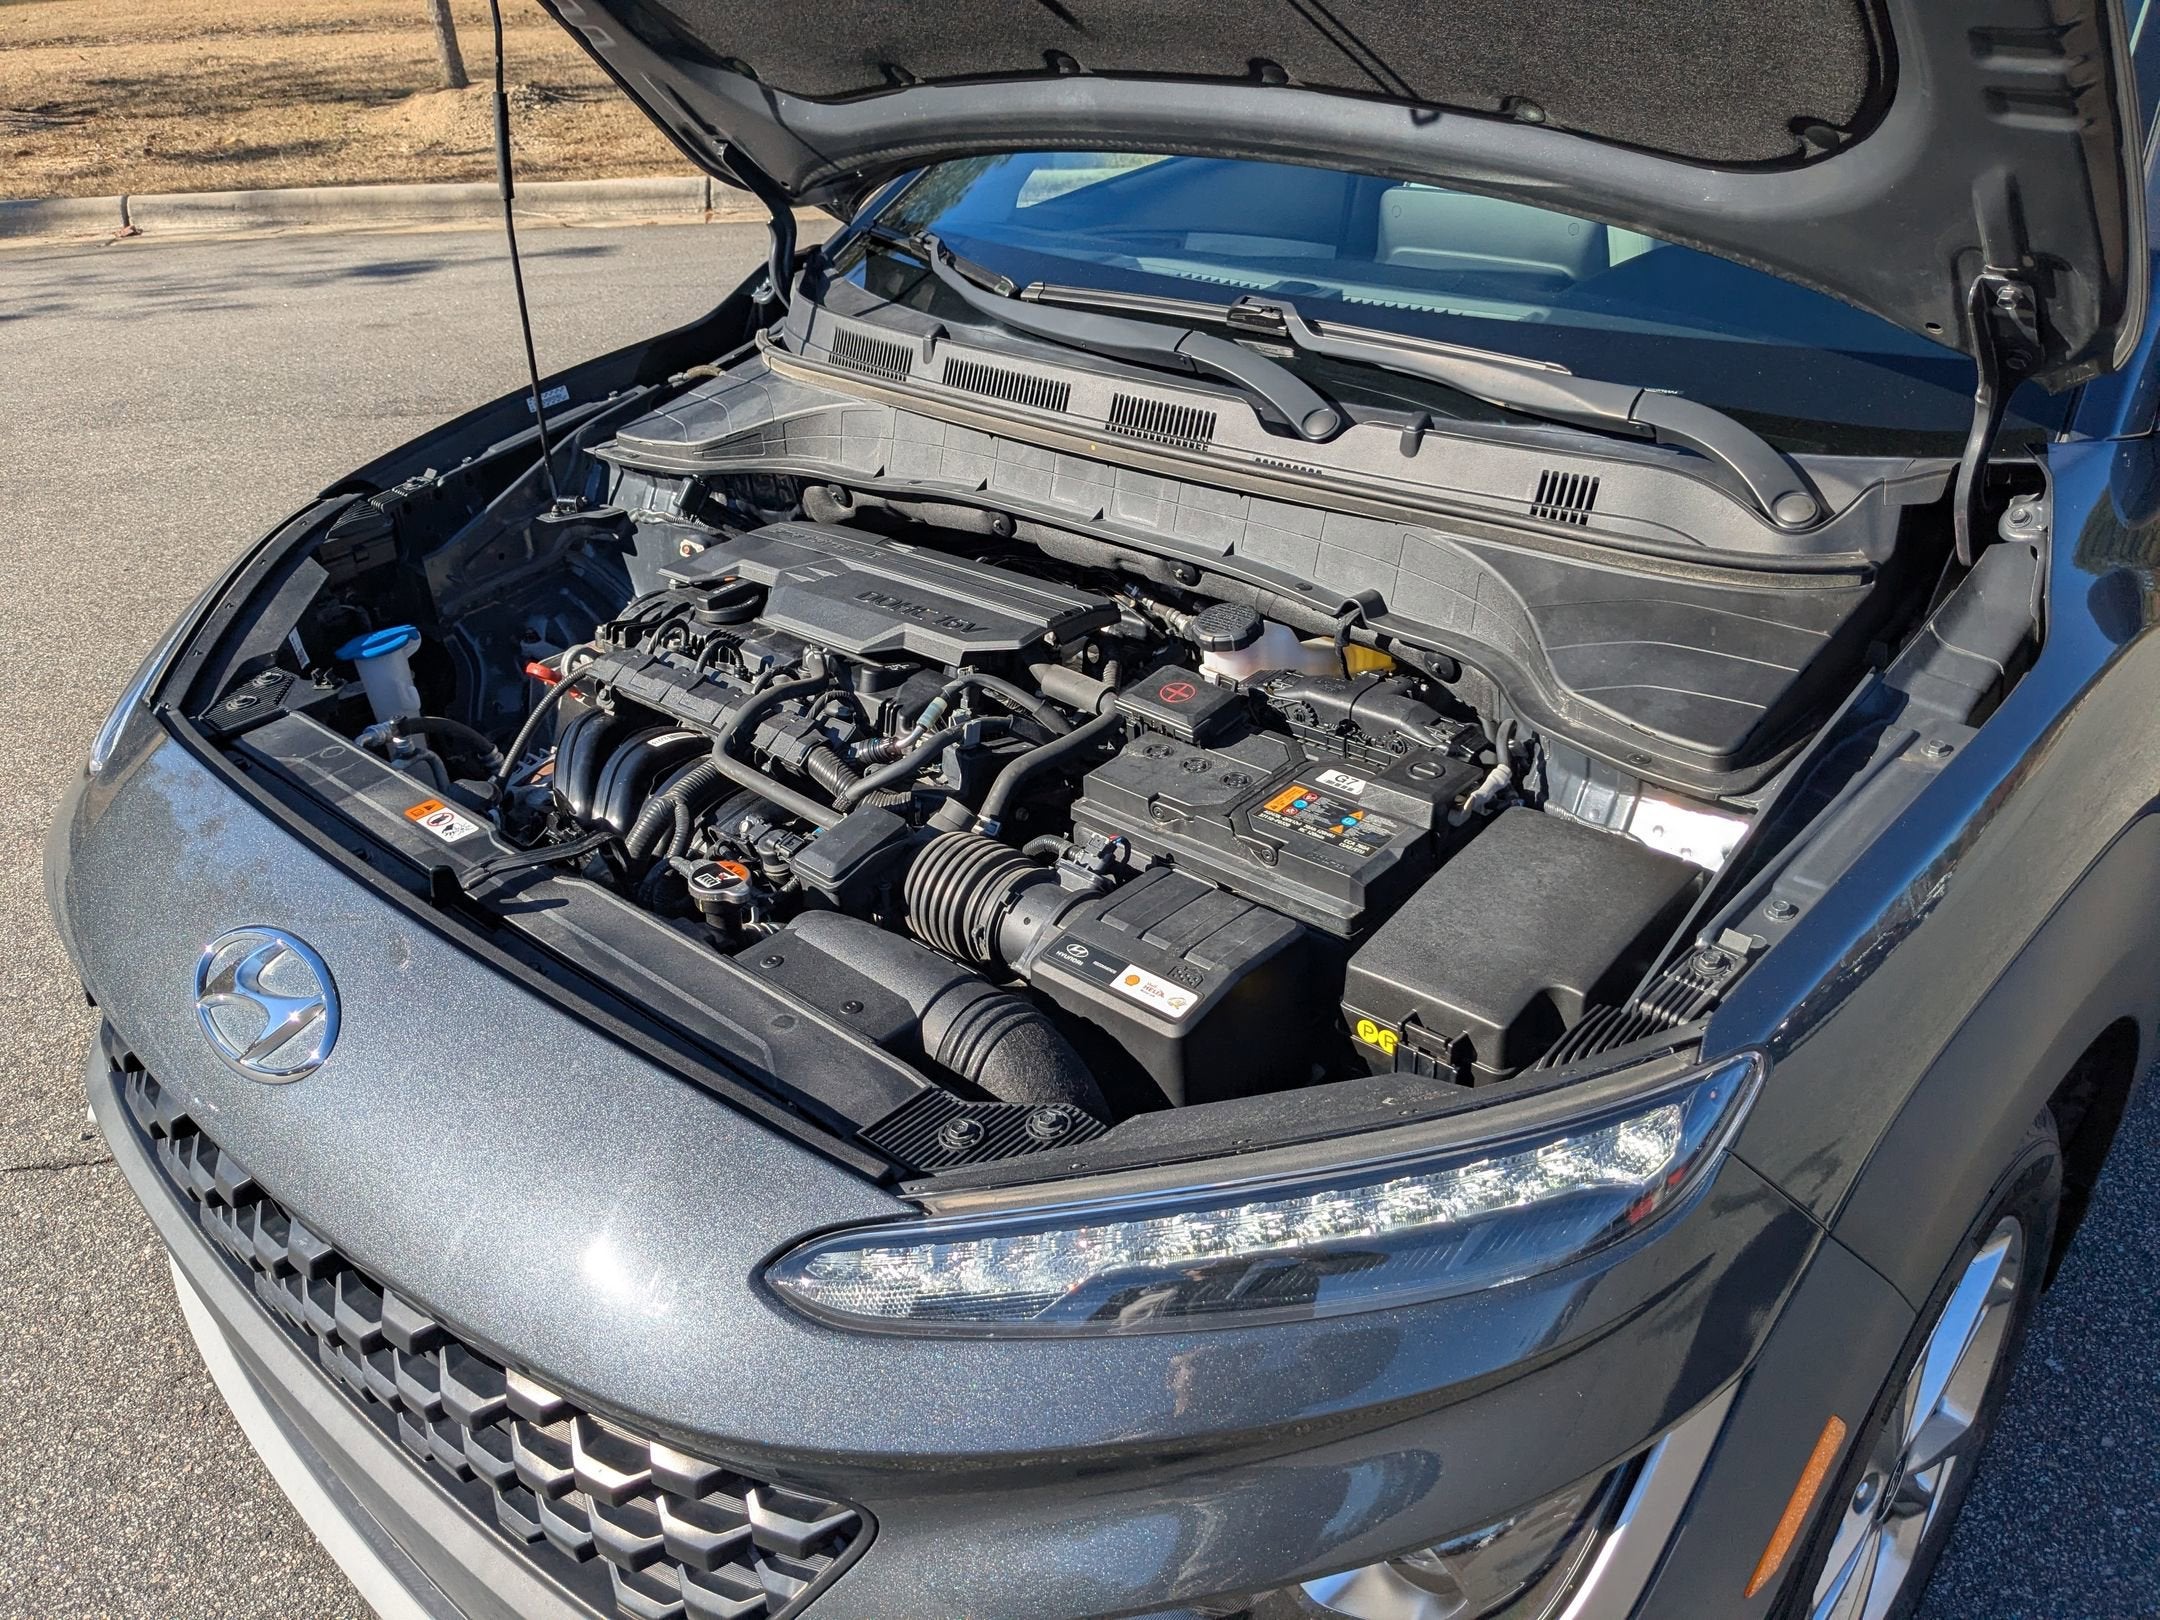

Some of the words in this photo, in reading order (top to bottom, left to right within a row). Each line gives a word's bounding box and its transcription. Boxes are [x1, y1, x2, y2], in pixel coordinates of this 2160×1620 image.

[853, 590, 939, 620] DOHC
[932, 613, 992, 634] 16V
[1335, 774, 1360, 788] G7
[1056, 950, 1084, 966] HYUNDAI
[1363, 1024, 1374, 1037] P
